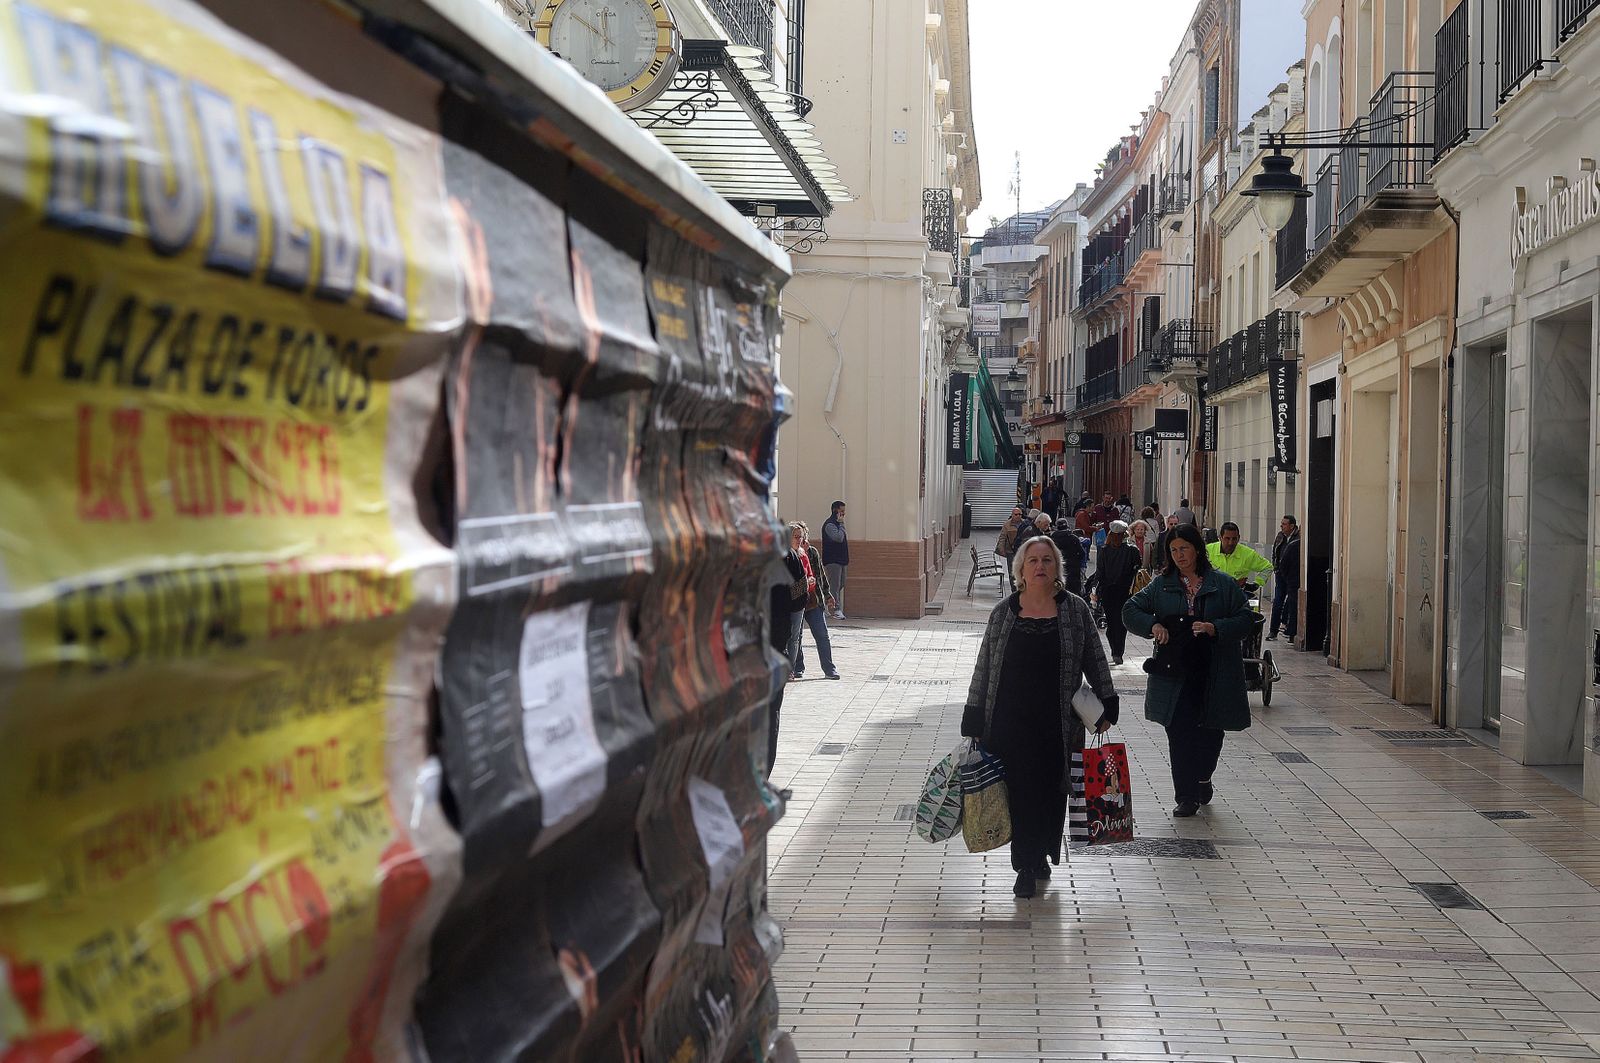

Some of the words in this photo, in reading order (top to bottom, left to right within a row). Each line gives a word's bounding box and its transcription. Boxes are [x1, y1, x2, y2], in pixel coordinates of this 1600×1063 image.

[20, 274, 198, 393] PLAZA
[203, 312, 265, 397] DE
[267, 327, 380, 412] TOROS
[1277, 366, 1285, 401] VIAJES
[954, 389, 962, 412] LOLA
[1277, 402, 1288, 413] El
[952, 420, 960, 449] BIMBA
[1277, 412, 1288, 434] Corte
[78, 402, 154, 522] LA
[165, 413, 342, 519] MERCED
